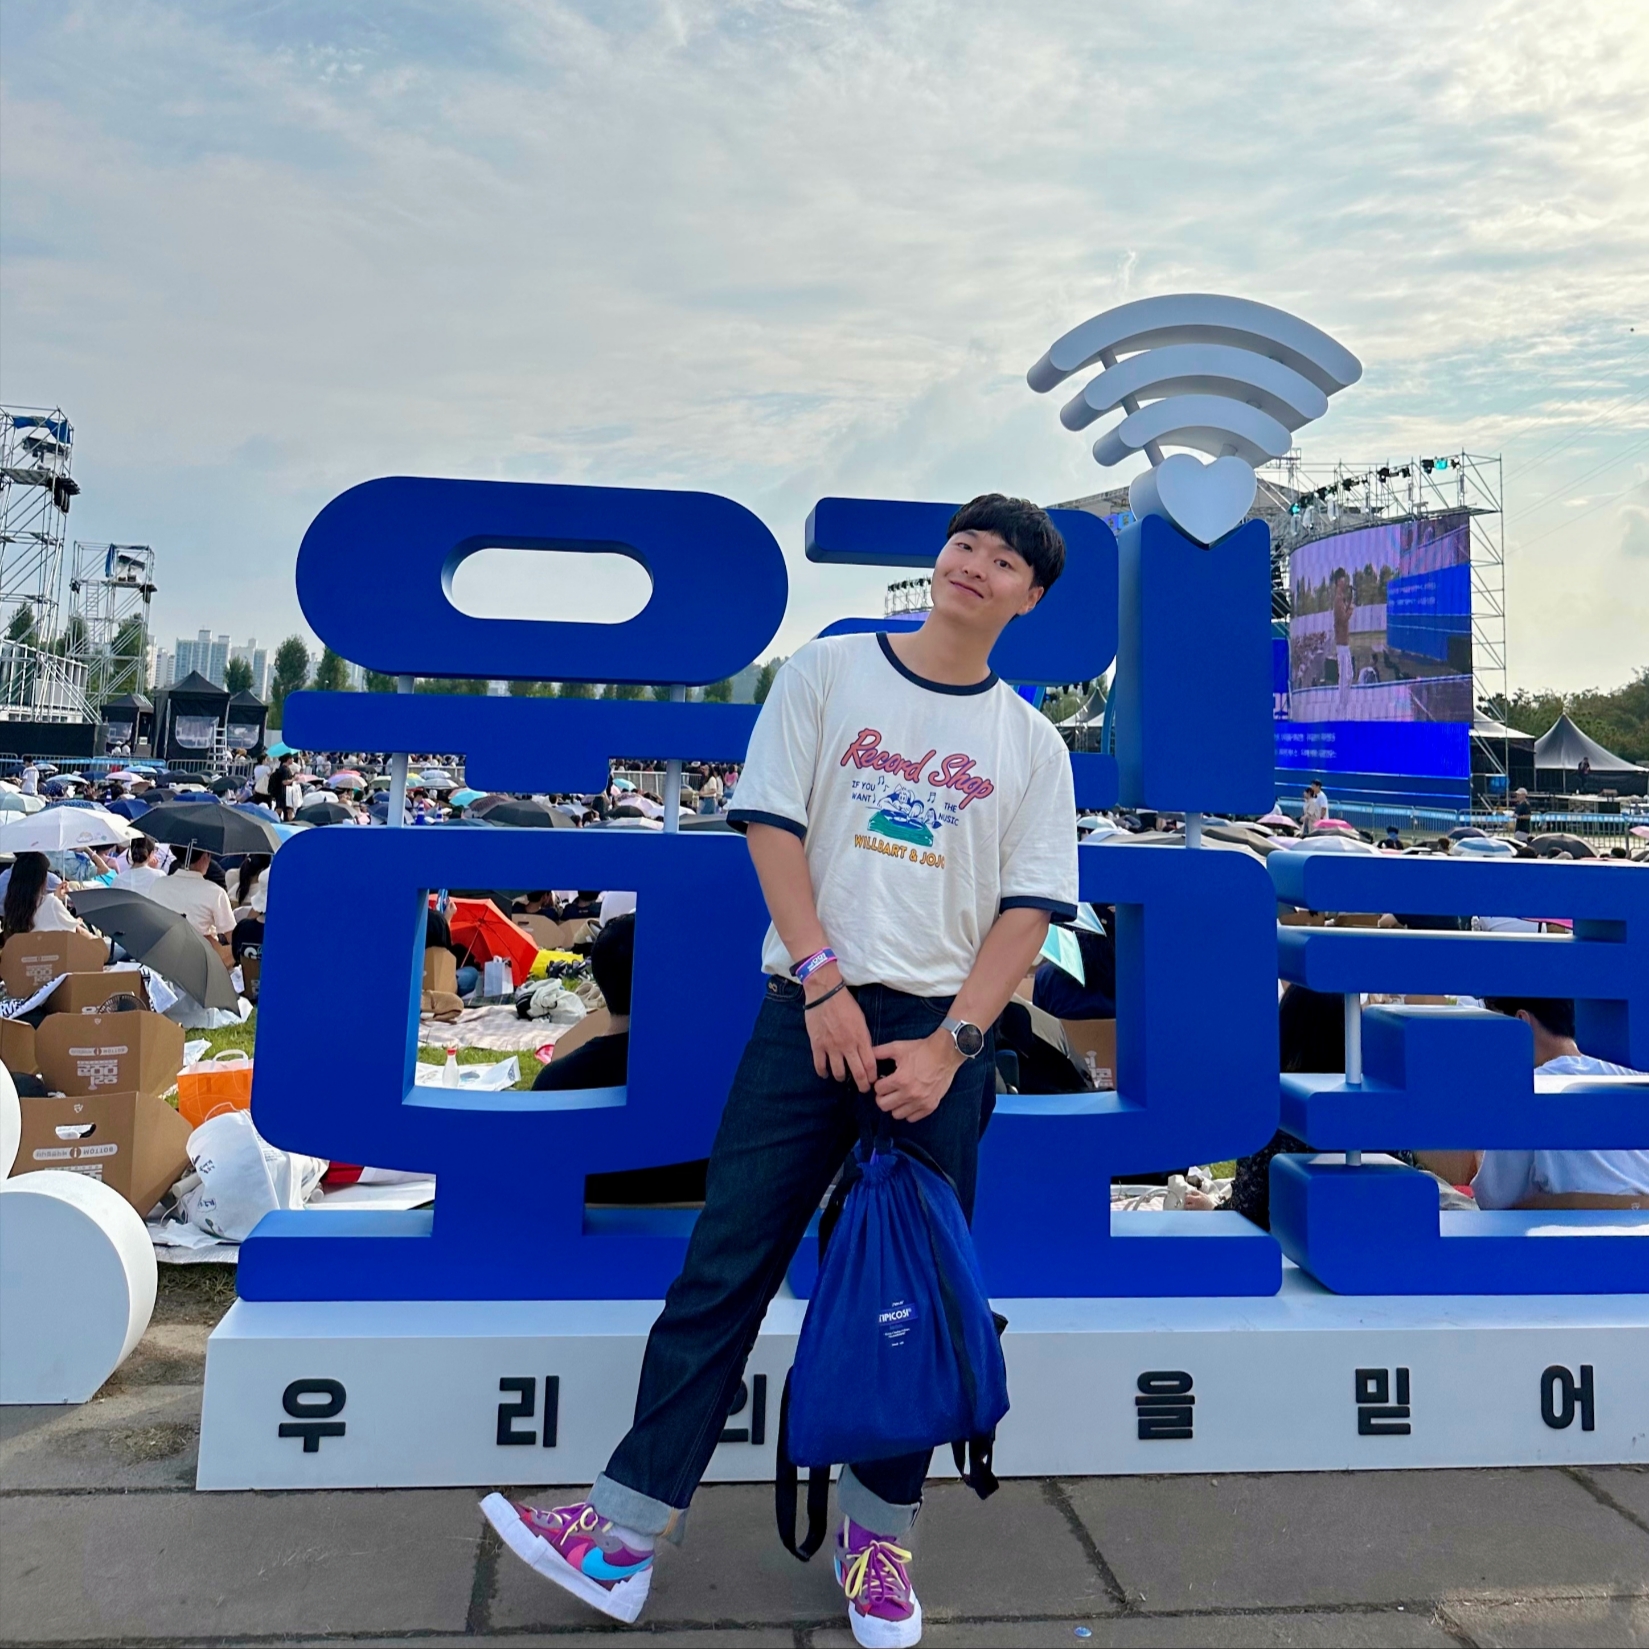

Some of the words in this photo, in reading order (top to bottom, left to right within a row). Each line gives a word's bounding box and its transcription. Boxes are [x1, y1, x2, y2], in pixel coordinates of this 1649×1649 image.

[840, 728, 937, 783] Record
[928, 753, 994, 810] Shop
[852, 780, 860, 789] IF
[861, 781, 876, 792] YOU
[852, 792, 871, 803] WANT
[944, 801, 957, 813] THE
[854, 834, 907, 859] WILLBART
[909, 849, 918, 862] &
[83, 1146, 113, 1156] BOTTOM
